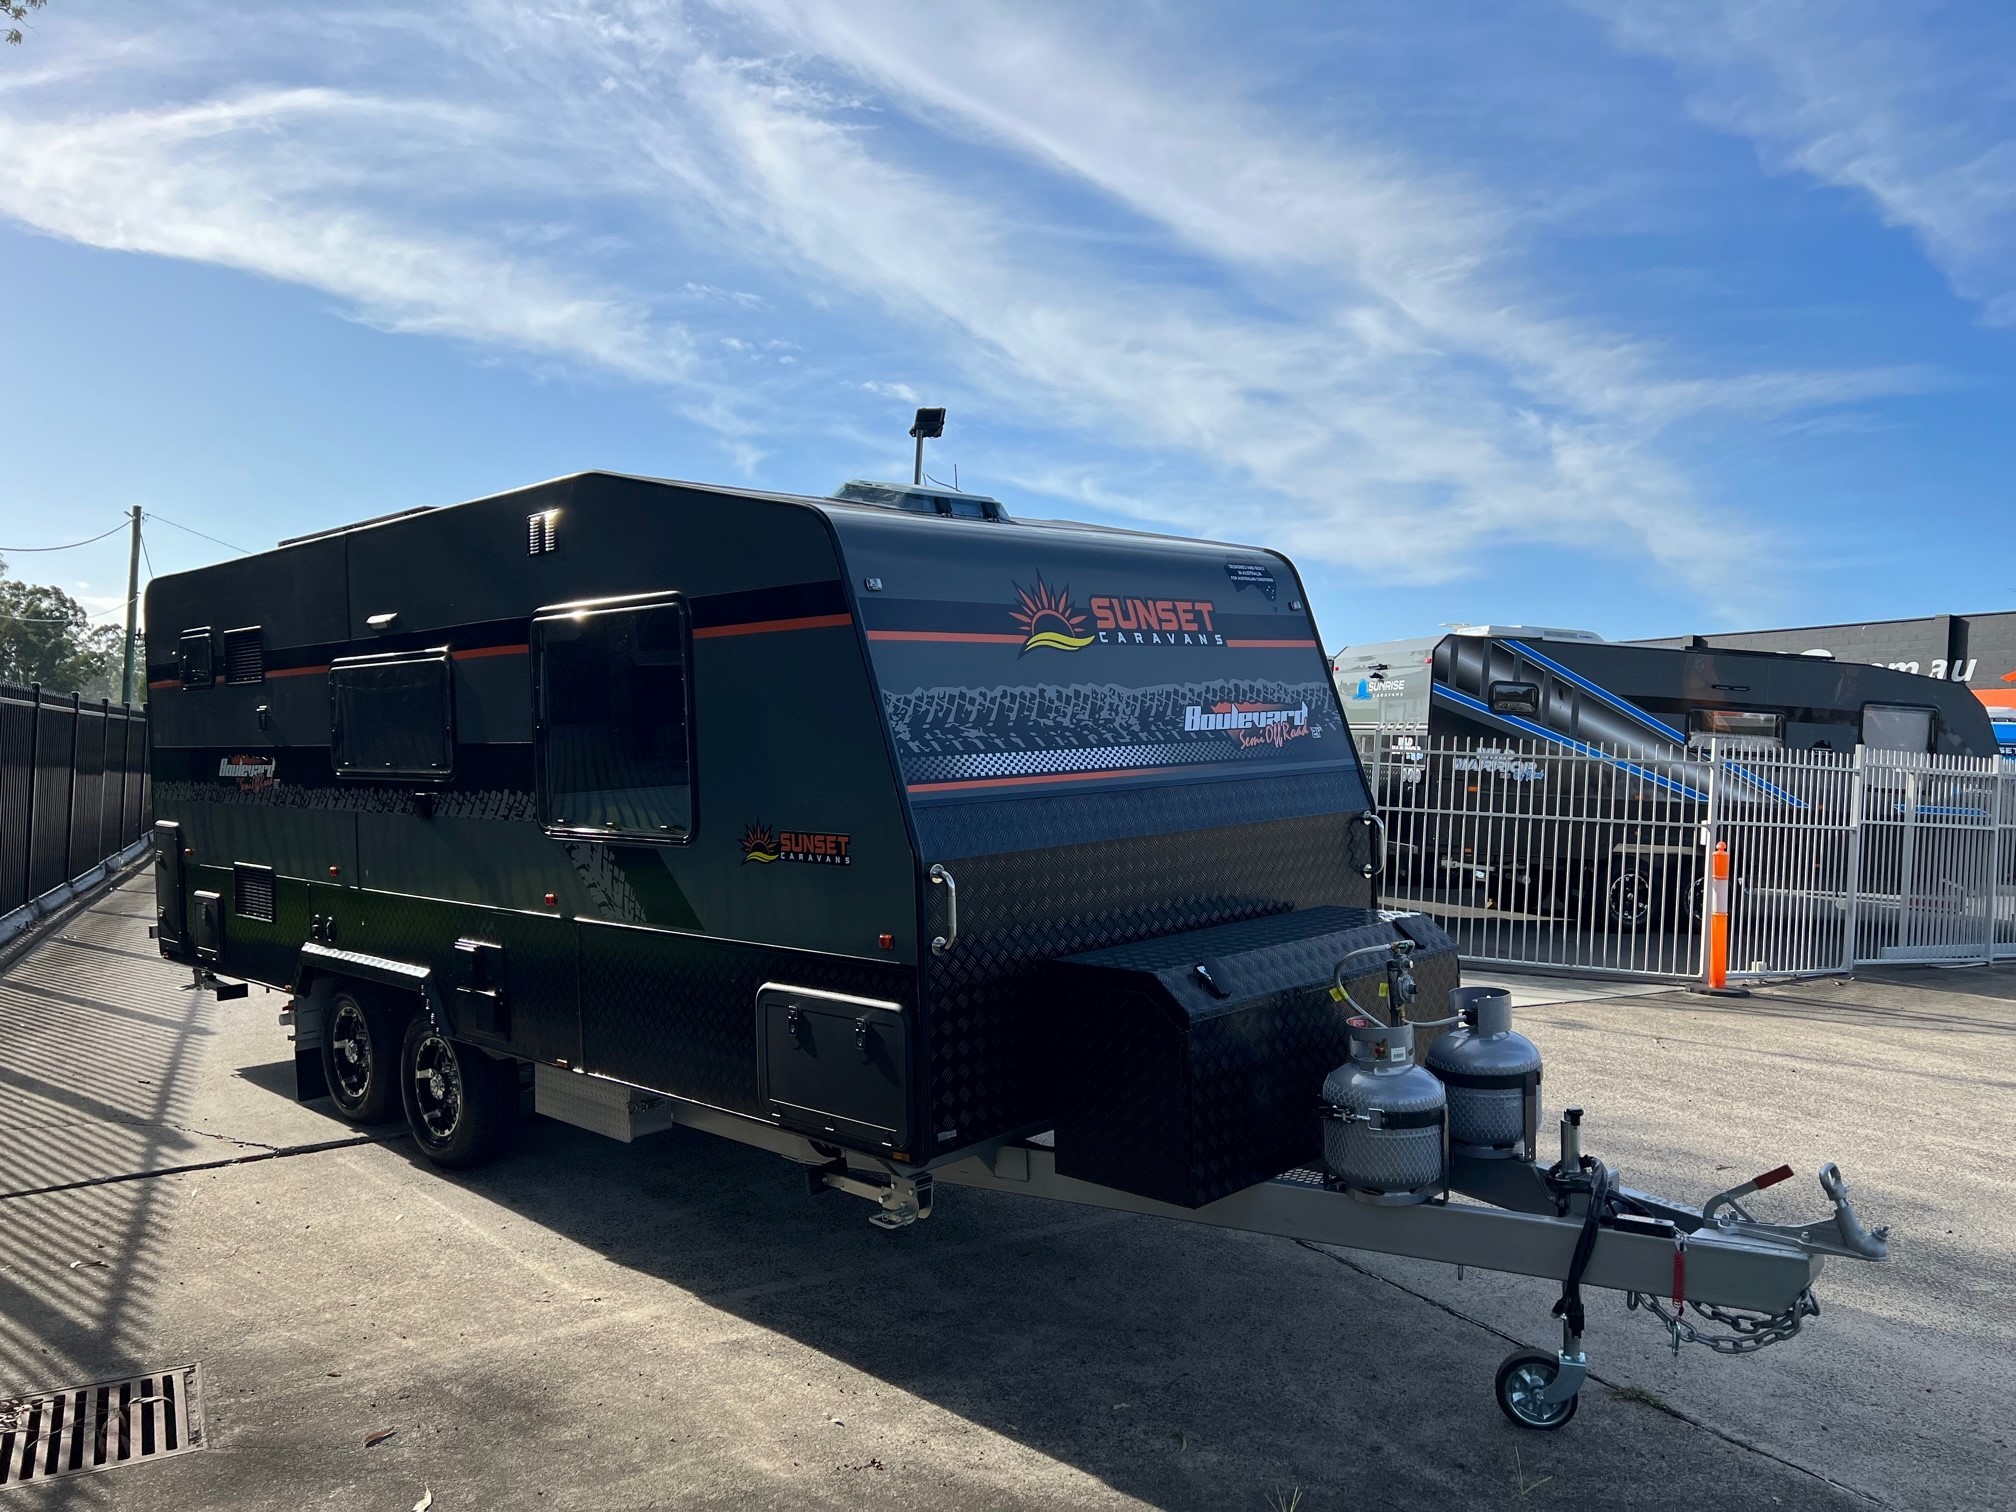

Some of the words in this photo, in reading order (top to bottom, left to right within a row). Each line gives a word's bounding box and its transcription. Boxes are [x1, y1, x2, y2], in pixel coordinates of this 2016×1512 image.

[1091, 597, 1214, 631] SUNSET
[1099, 631, 1223, 645] CARAVANS
[1368, 680, 1405, 692] SUNRISE
[1184, 701, 1308, 731] Boulevard
[1239, 728, 1265, 750] Semi
[1281, 715, 1309, 741] Road
[219, 756, 276, 778] Boulevard
[780, 833, 849, 856] SUNSET
[780, 852, 850, 865] CARAVANS
